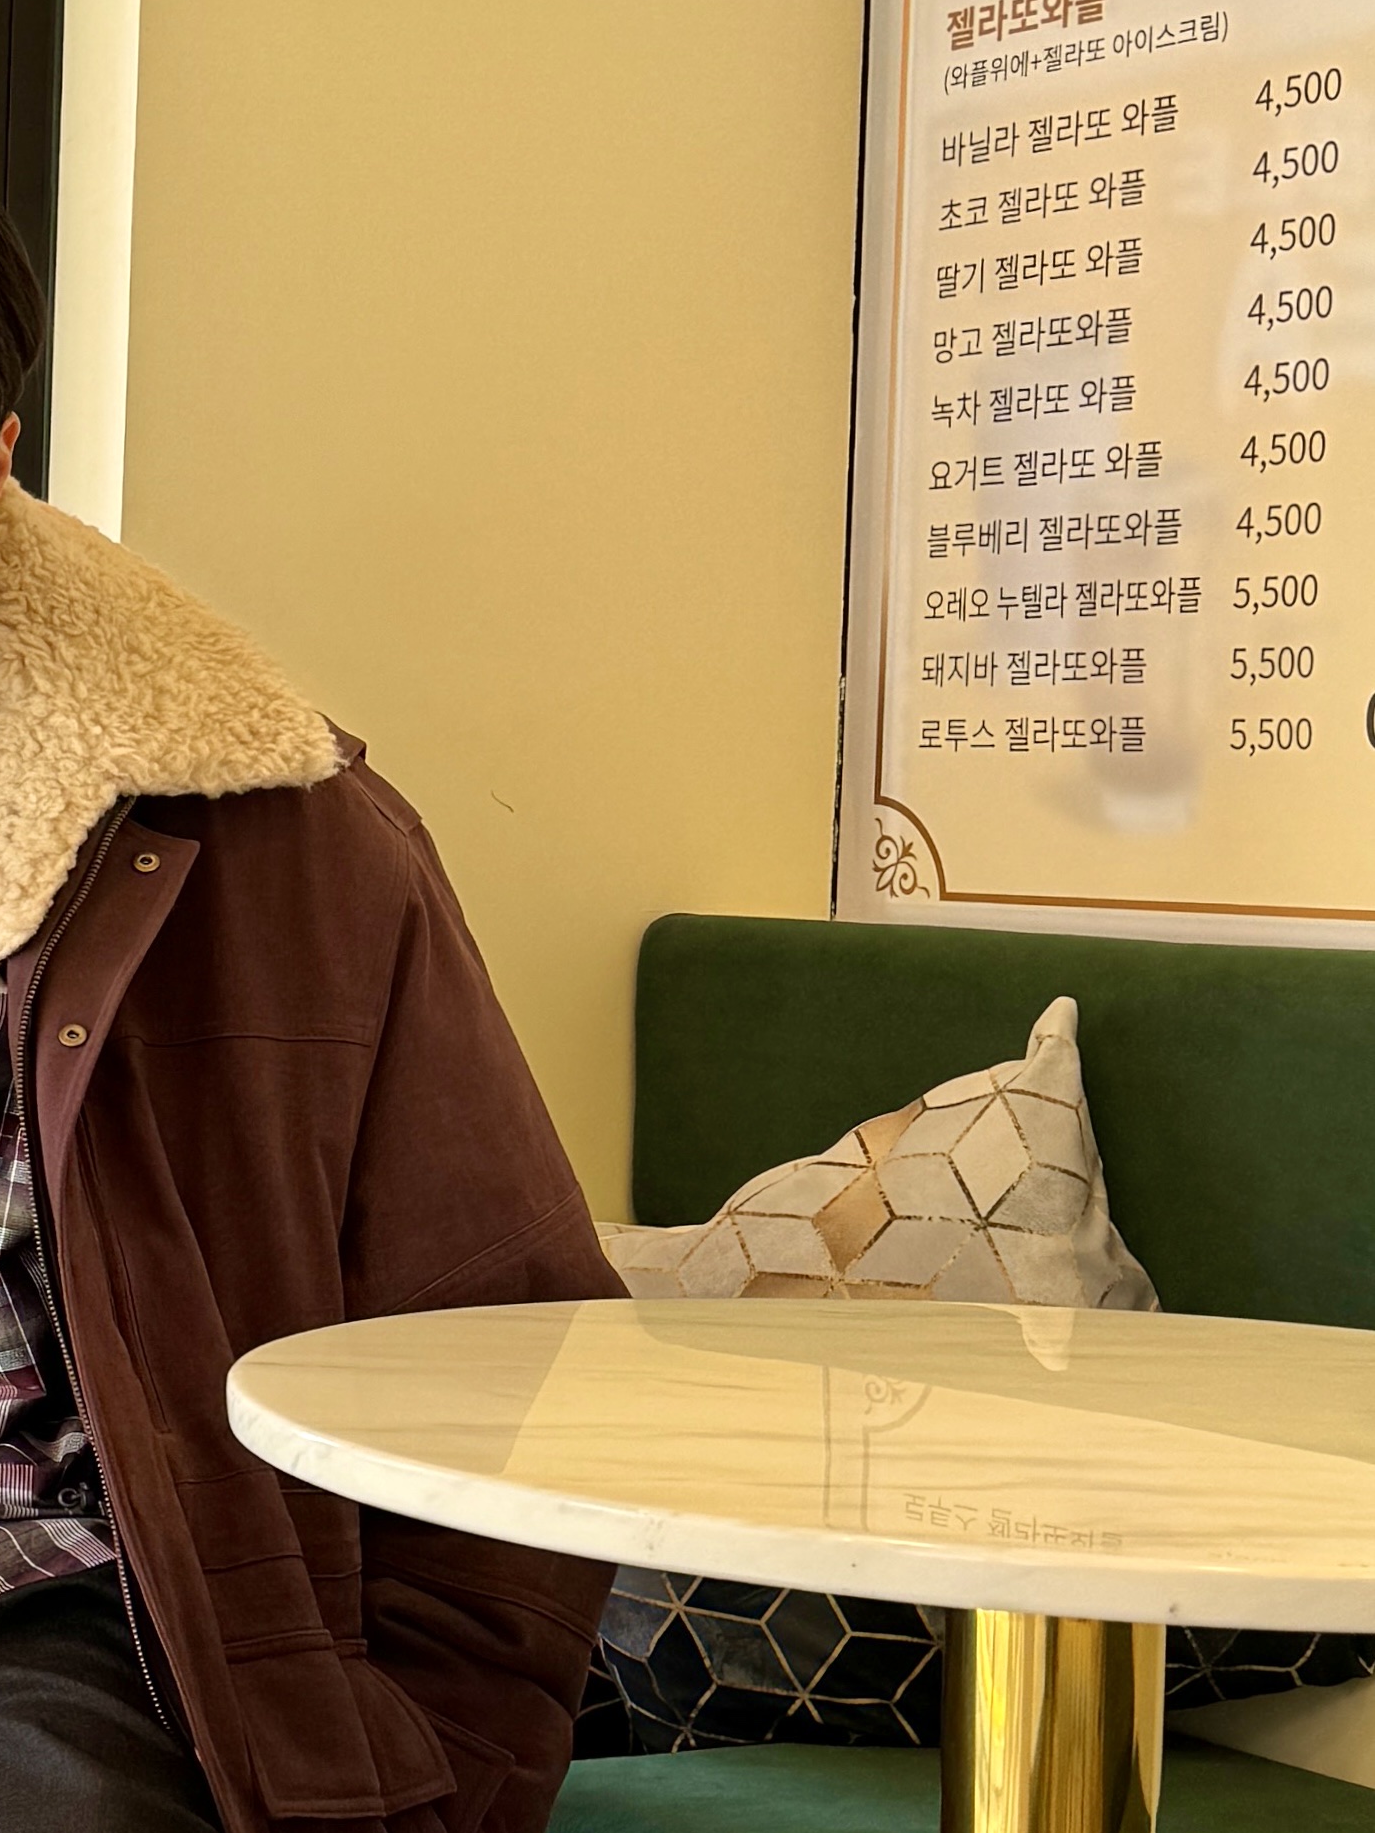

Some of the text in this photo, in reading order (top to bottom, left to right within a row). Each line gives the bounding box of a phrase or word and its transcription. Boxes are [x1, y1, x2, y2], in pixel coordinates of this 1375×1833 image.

[943, 11, 1229, 96] (와플위에+젤라또 아이스크림)
[942, 67, 1343, 168] 바닐라 젤라또 와플 4,500
[938, 140, 1340, 233] 초코 젤라또 와플 4,500
[937, 212, 1337, 299] 딸기 젤라또 와플 4,500
[933, 285, 1334, 365] 망고 젤라또와플 4,500
[930, 357, 1330, 429] 녹차 젤라또 와플 4,500
[928, 429, 1327, 492] 요거트 젤라또 와플 4,500
[926, 502, 1323, 559] 블루베리 젤라또와플 4,500
[923, 573, 1319, 623] 오레오 누텔라 젤라또와플 5,500
[921, 645, 1316, 688] 돼지바 젤라또와플 5,500
[918, 714, 1314, 757] 로투스 젤라또와플 5,500
